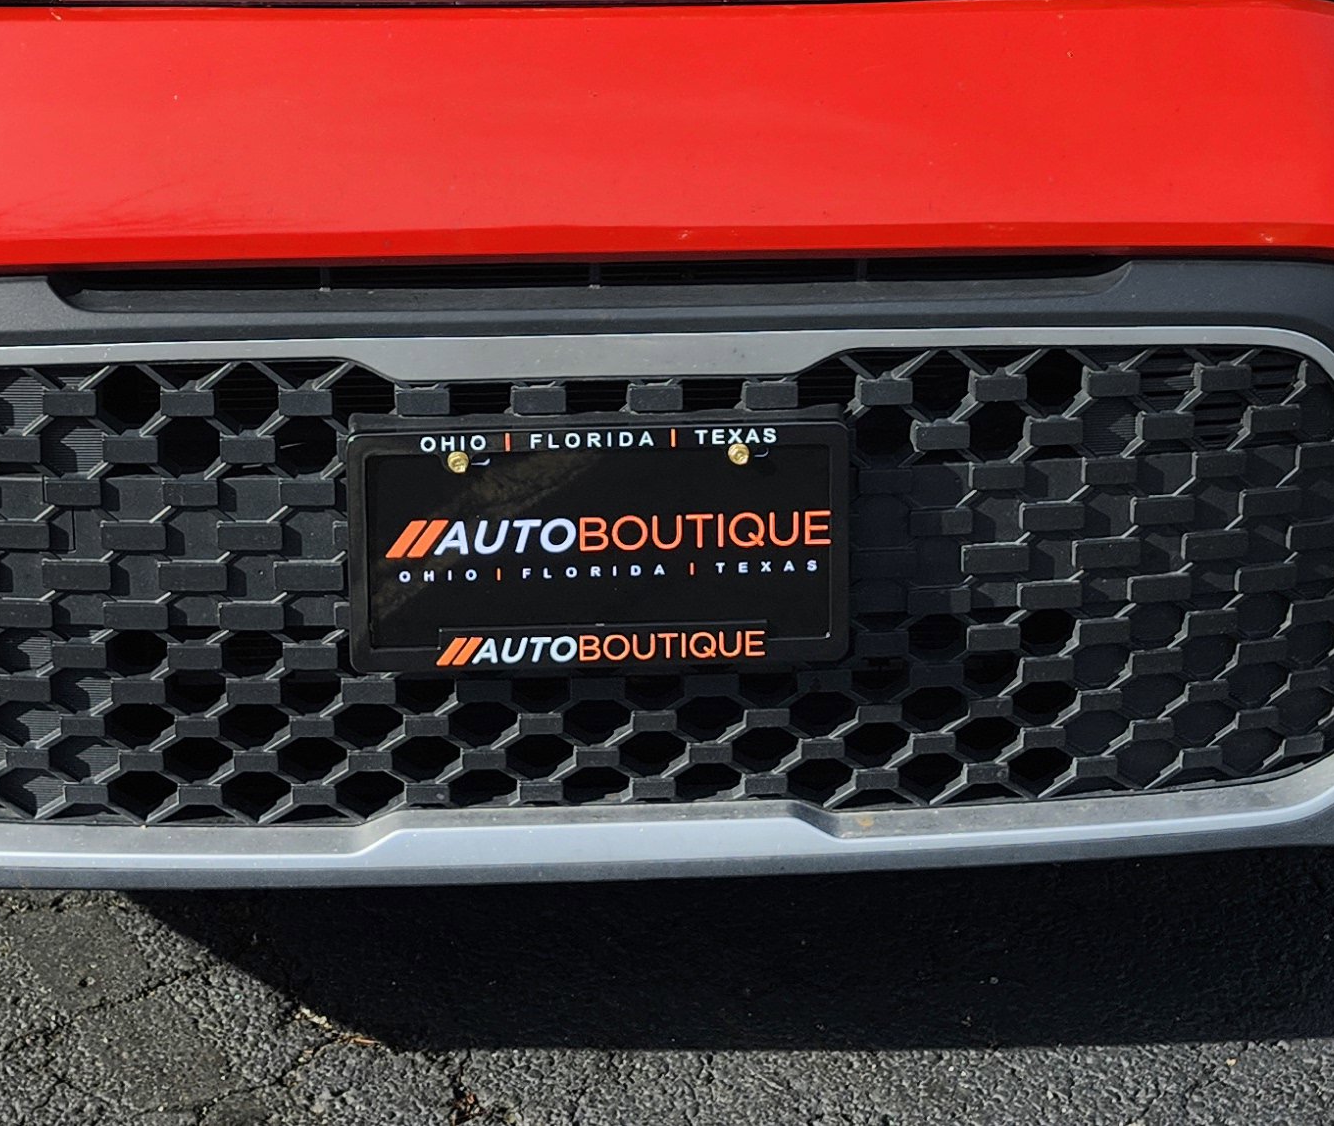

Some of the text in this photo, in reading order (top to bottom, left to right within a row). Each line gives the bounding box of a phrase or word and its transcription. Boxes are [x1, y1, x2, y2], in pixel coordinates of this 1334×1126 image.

[420, 427, 777, 453] OHIO FLORIDA TEXAS
[434, 510, 832, 557] AUTOBOUTIQUE
[398, 559, 819, 583] OHIO FLORIDA TEXAS
[472, 630, 766, 665] AUTOBOUTIQUE
